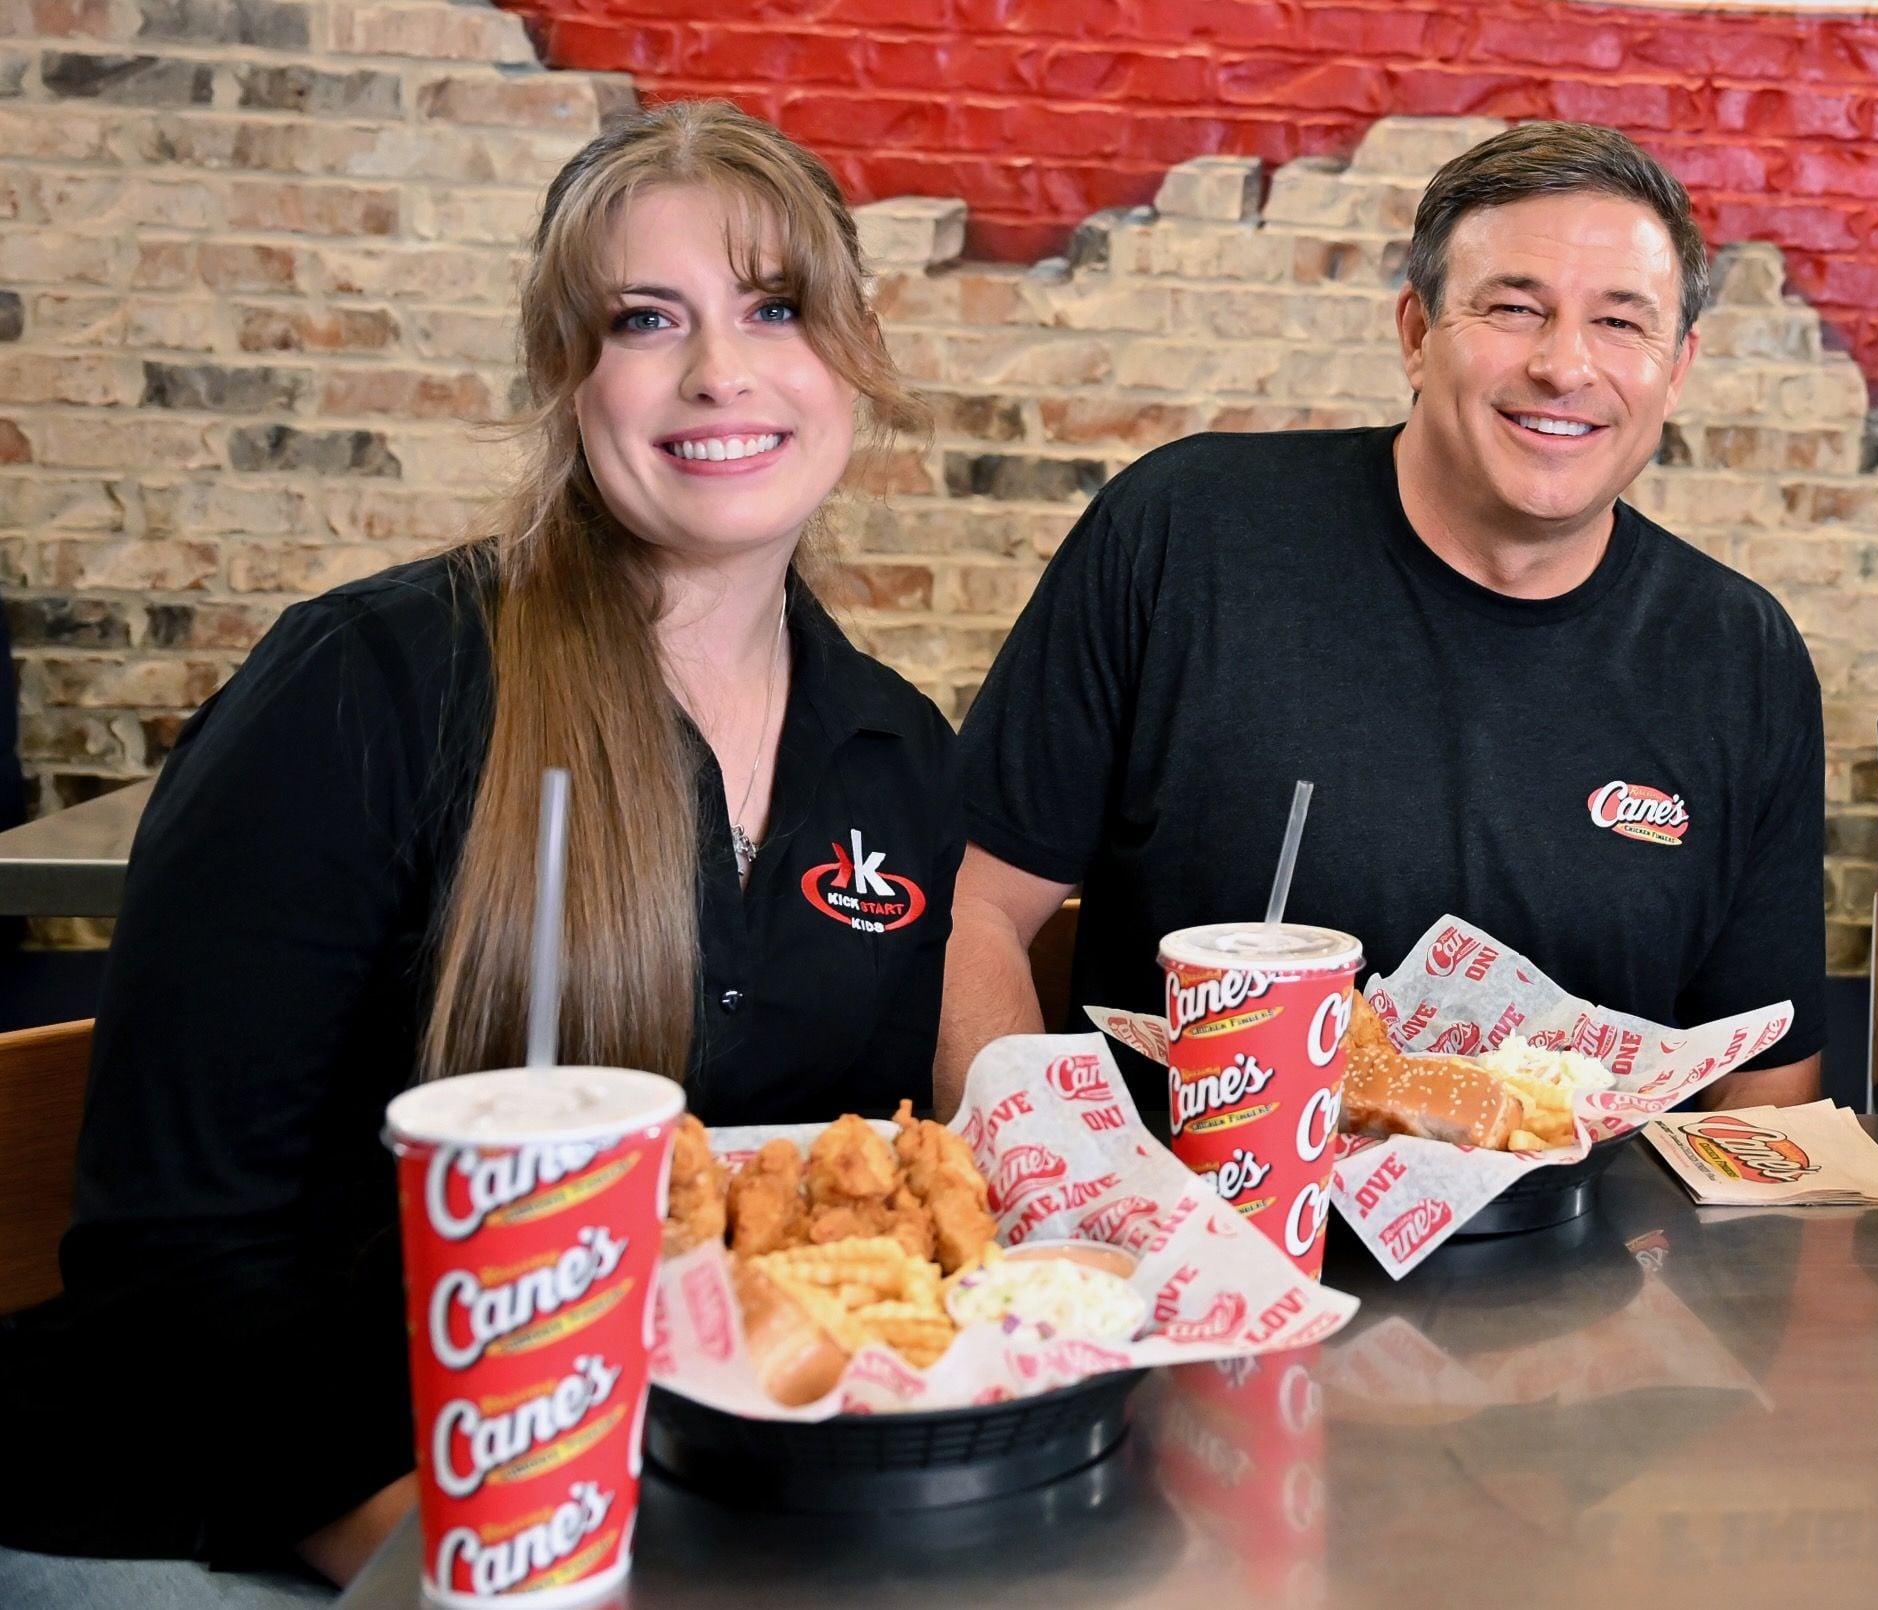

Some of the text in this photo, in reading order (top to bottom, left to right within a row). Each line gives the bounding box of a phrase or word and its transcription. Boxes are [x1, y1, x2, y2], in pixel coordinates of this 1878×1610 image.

[1591, 780, 1689, 828] Cane's
[828, 892, 905, 915] KICK START
[851, 917, 885, 933] KIDS
[1486, 1002, 1526, 1049] OVE
[1611, 1030, 1643, 1075] ONE
[1168, 1053, 1276, 1136] Cane's
[1355, 1152, 1408, 1219] OVE
[1008, 1196, 1061, 1246] ONE
[429, 1226, 629, 1369] Cane's
[1153, 1264, 1199, 1322] OVE
[431, 1355, 623, 1498] Cane's
[437, 1481, 615, 1597] Cane's
